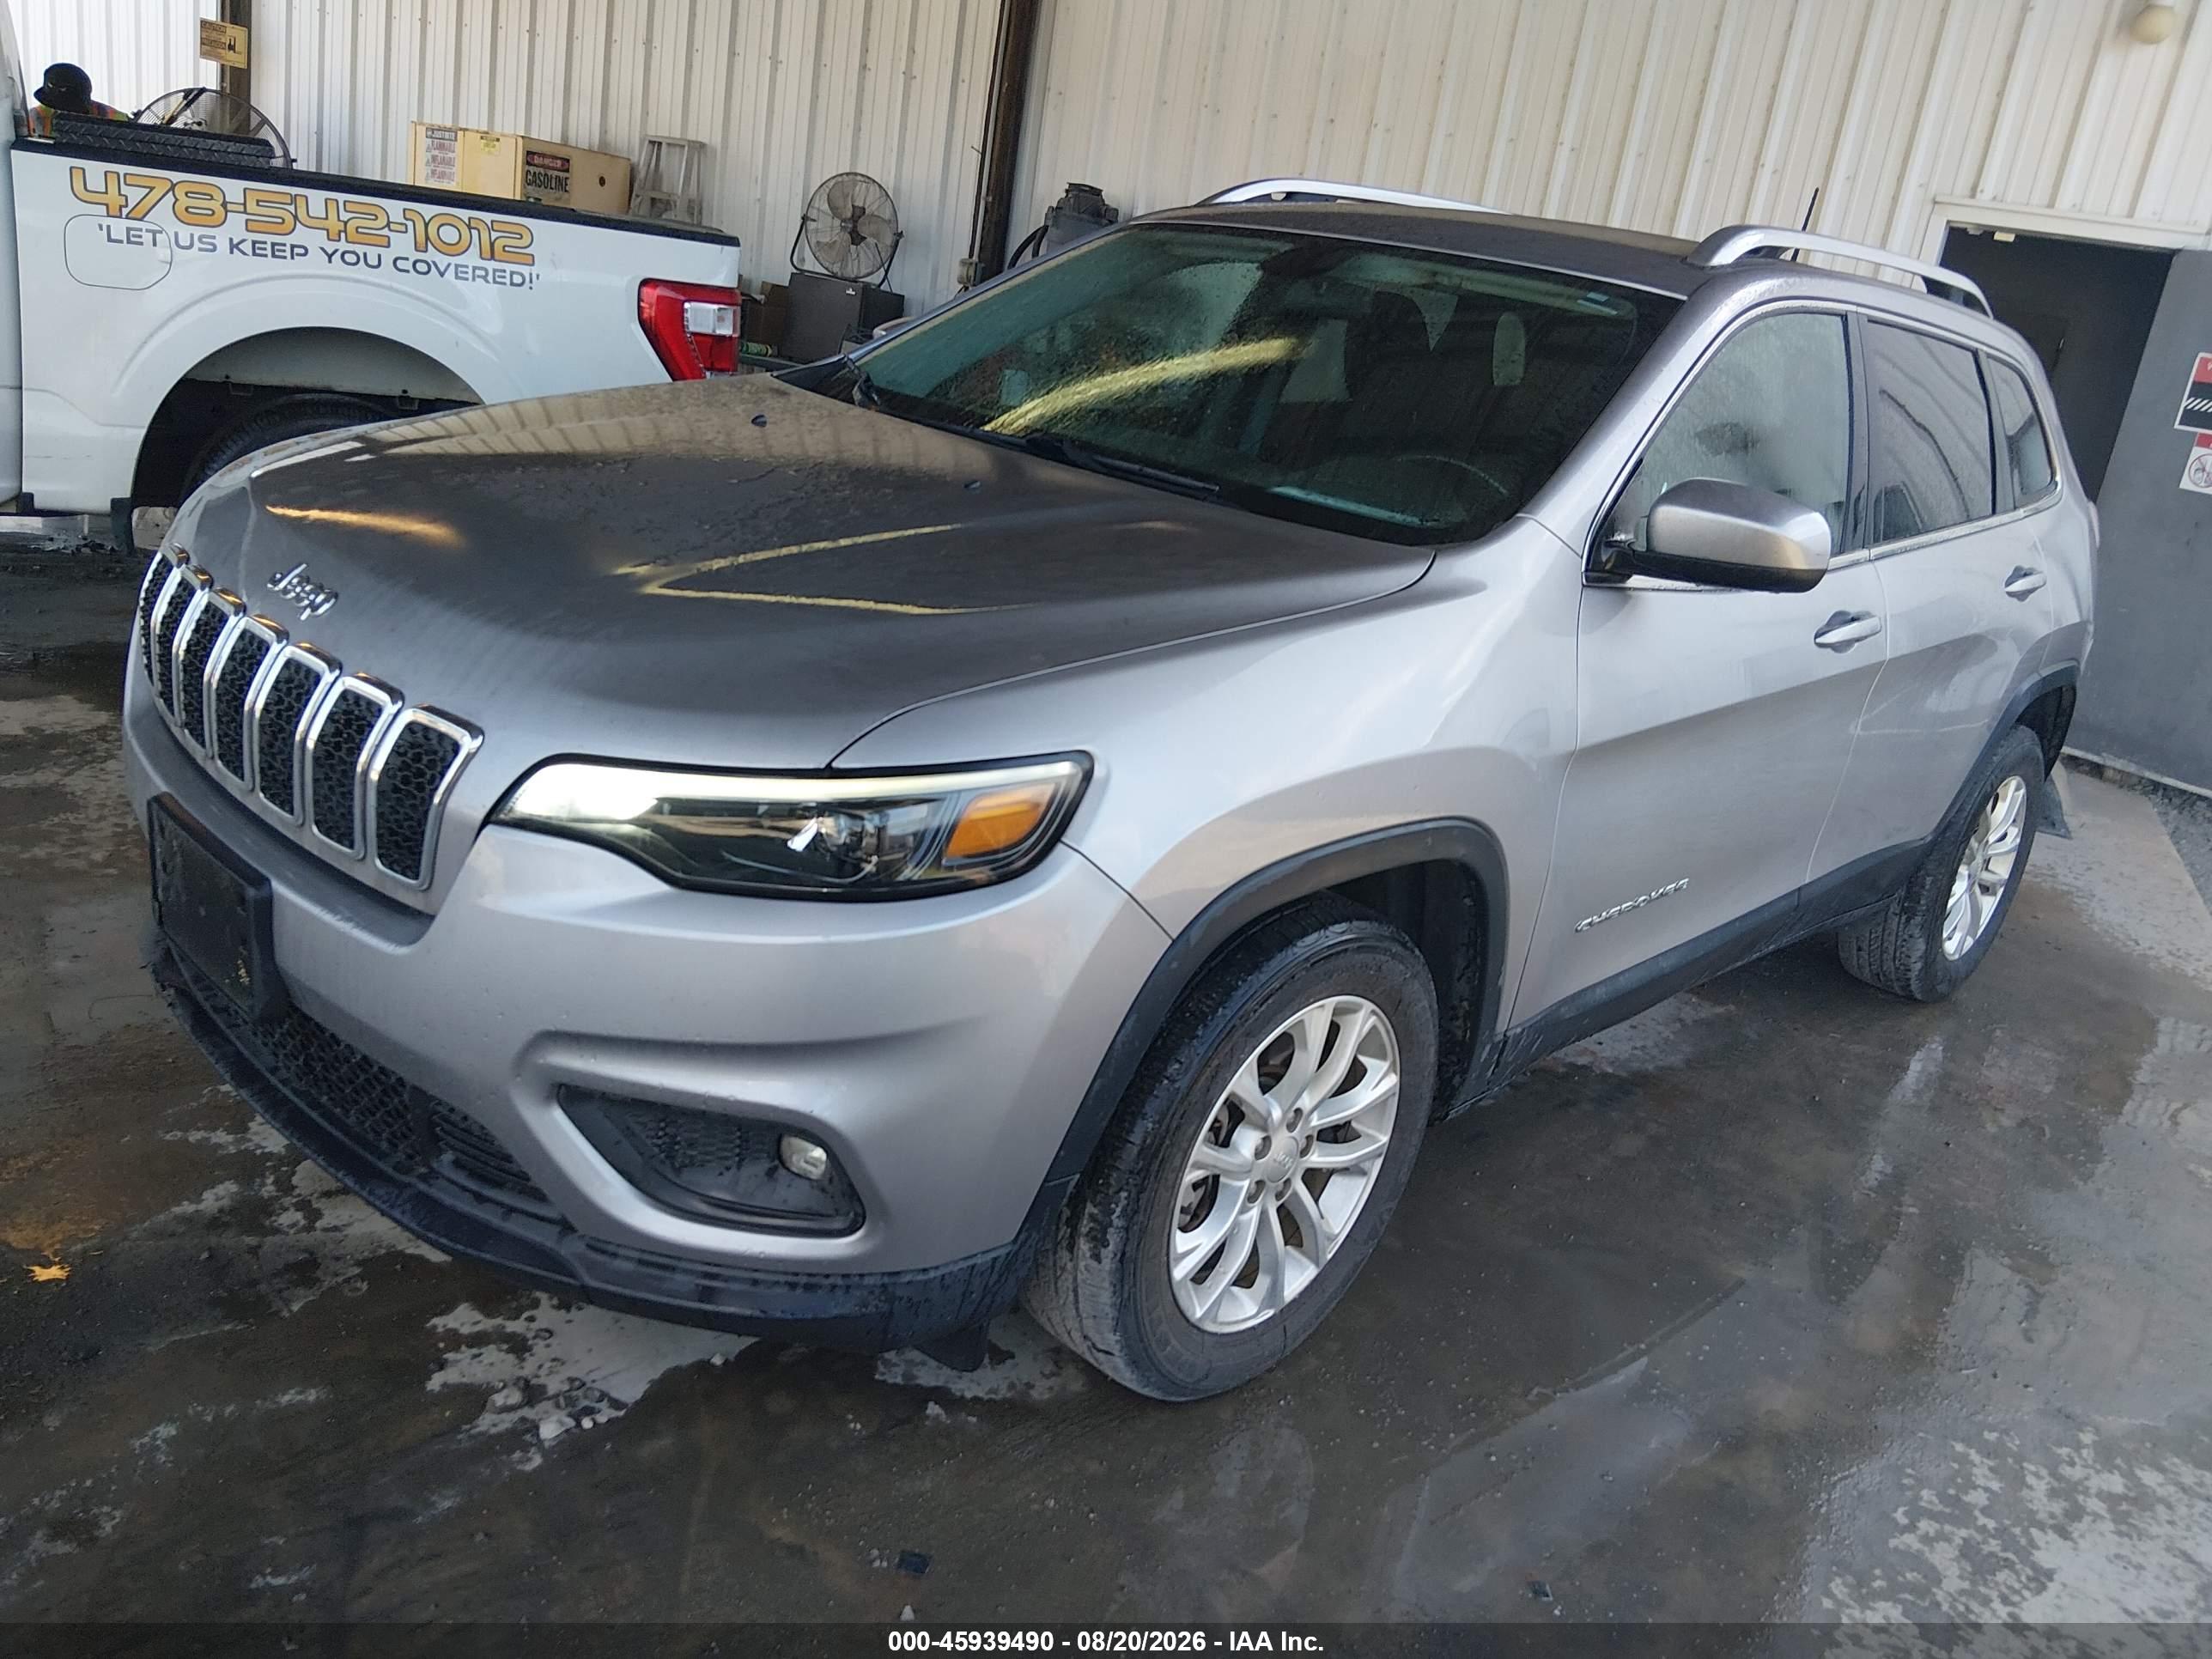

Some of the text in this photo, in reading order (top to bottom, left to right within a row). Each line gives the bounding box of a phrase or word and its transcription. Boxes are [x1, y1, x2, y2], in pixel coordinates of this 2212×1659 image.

[526, 169, 569, 193] GASOLINE
[533, 154, 562, 169] DANGER
[70, 166, 535, 266] 478-542-1012
[173, 230, 217, 253] US
[228, 237, 308, 260] KEEP
[319, 246, 382, 269] YOU
[267, 562, 337, 620] Jeep
